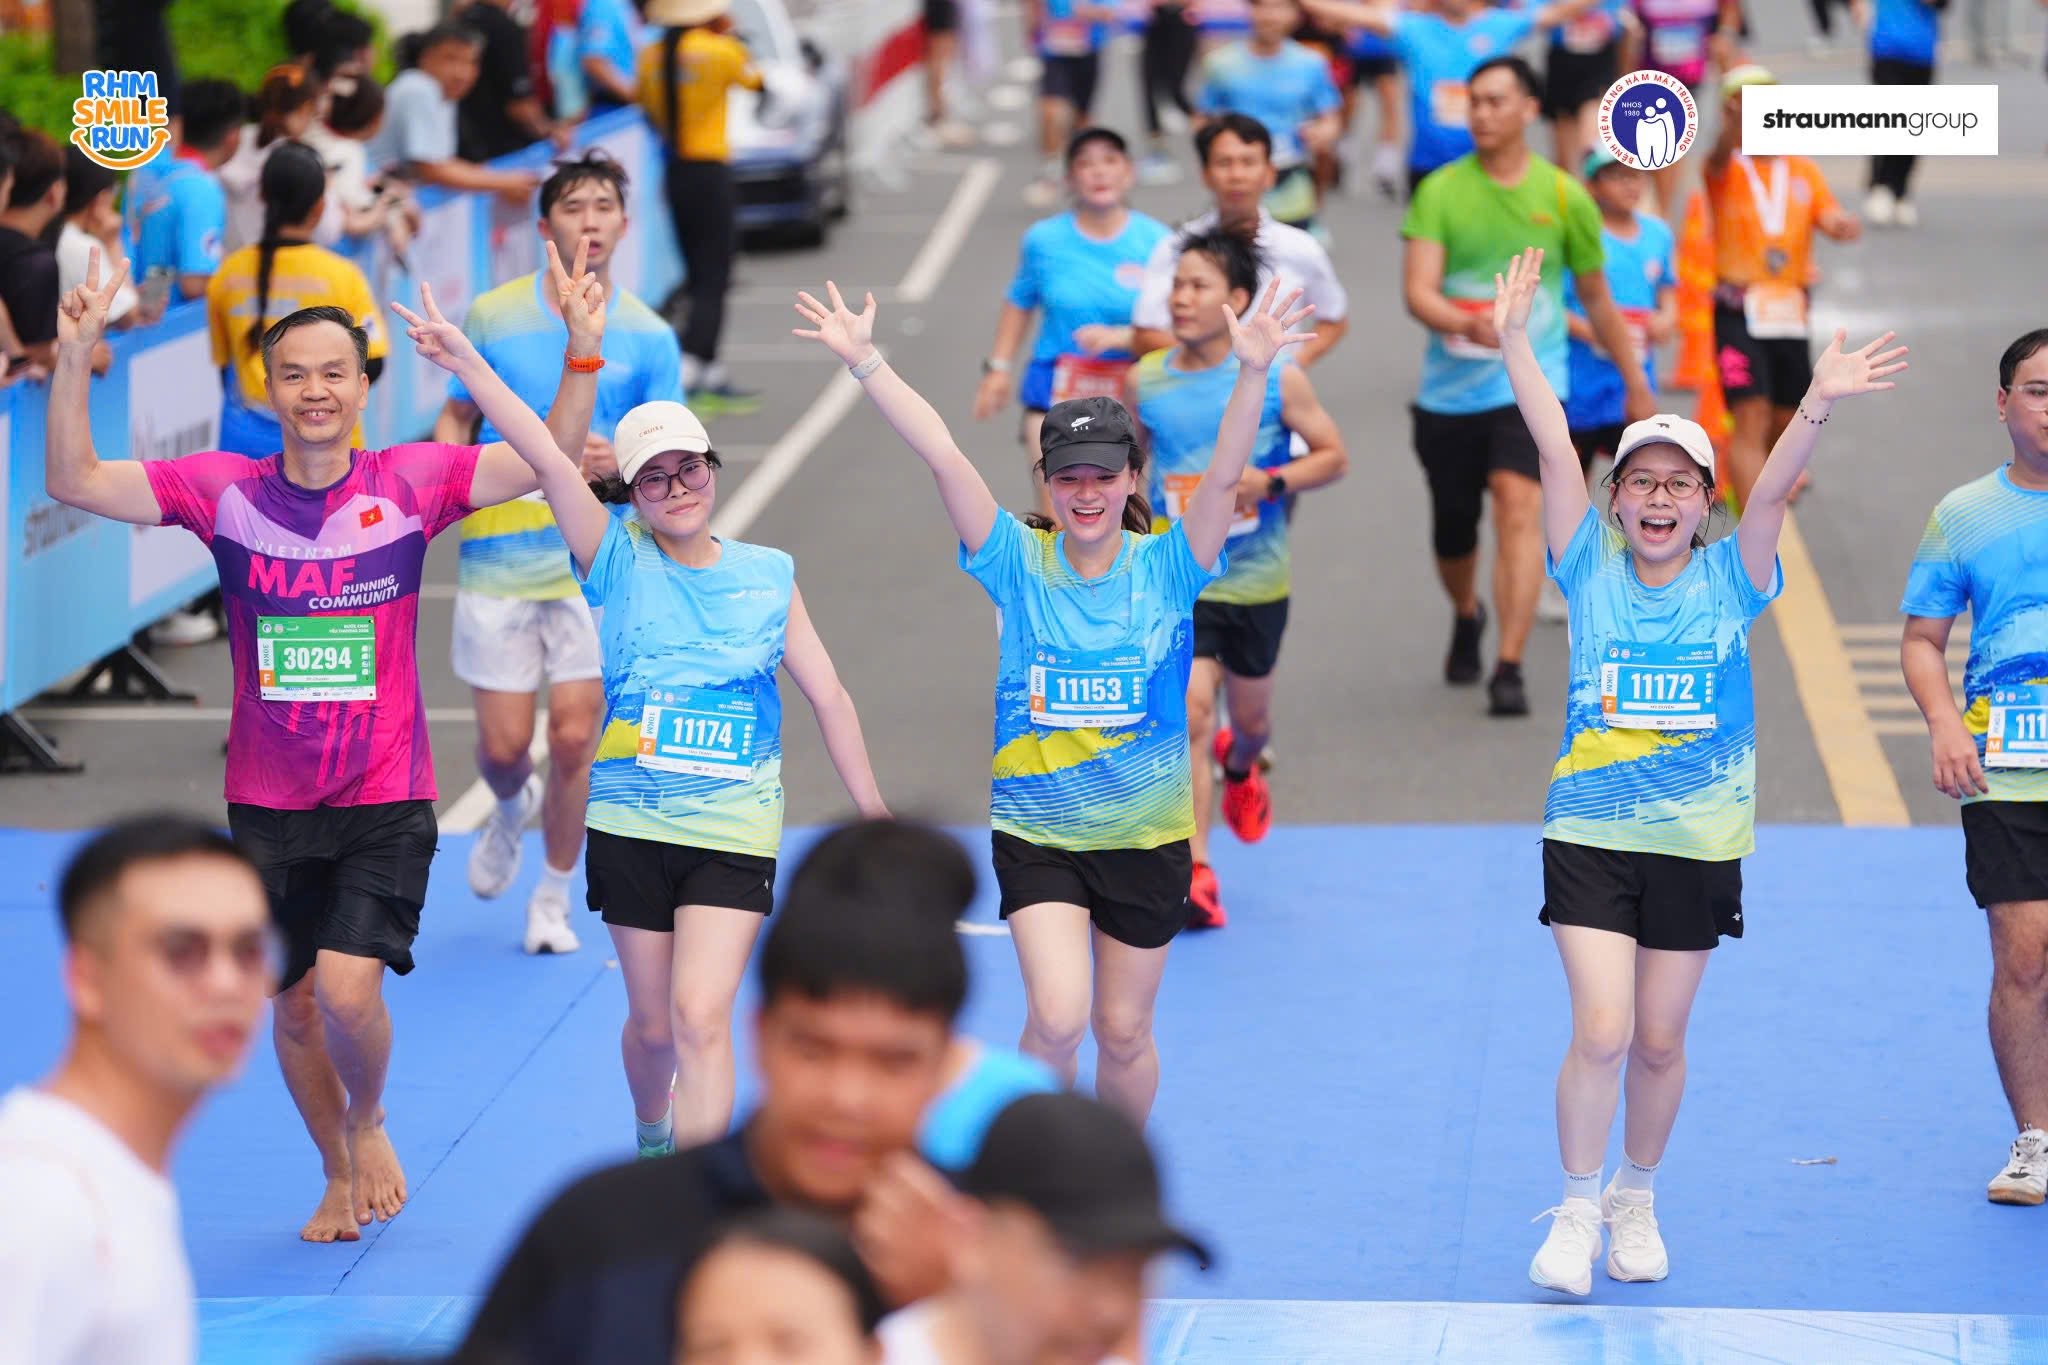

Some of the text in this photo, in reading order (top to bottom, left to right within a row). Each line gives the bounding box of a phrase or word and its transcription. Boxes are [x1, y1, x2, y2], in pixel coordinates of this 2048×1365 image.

[255, 541, 351, 559] VIETNAM
[248, 554, 355, 598] MAF
[342, 574, 395, 595] RUNNING
[308, 583, 399, 610] COMMUNITY
[283, 647, 352, 670] 30294
[263, 673, 271, 685] F
[1057, 677, 1122, 702] 11153
[1631, 672, 1695, 700] 11172
[1034, 699, 1041, 709] F
[1605, 699, 1613, 710] F
[646, 711, 655, 735] 10KM
[673, 716, 733, 749] 11174
[643, 741, 652, 752] F
[1989, 741, 2001, 751] M
